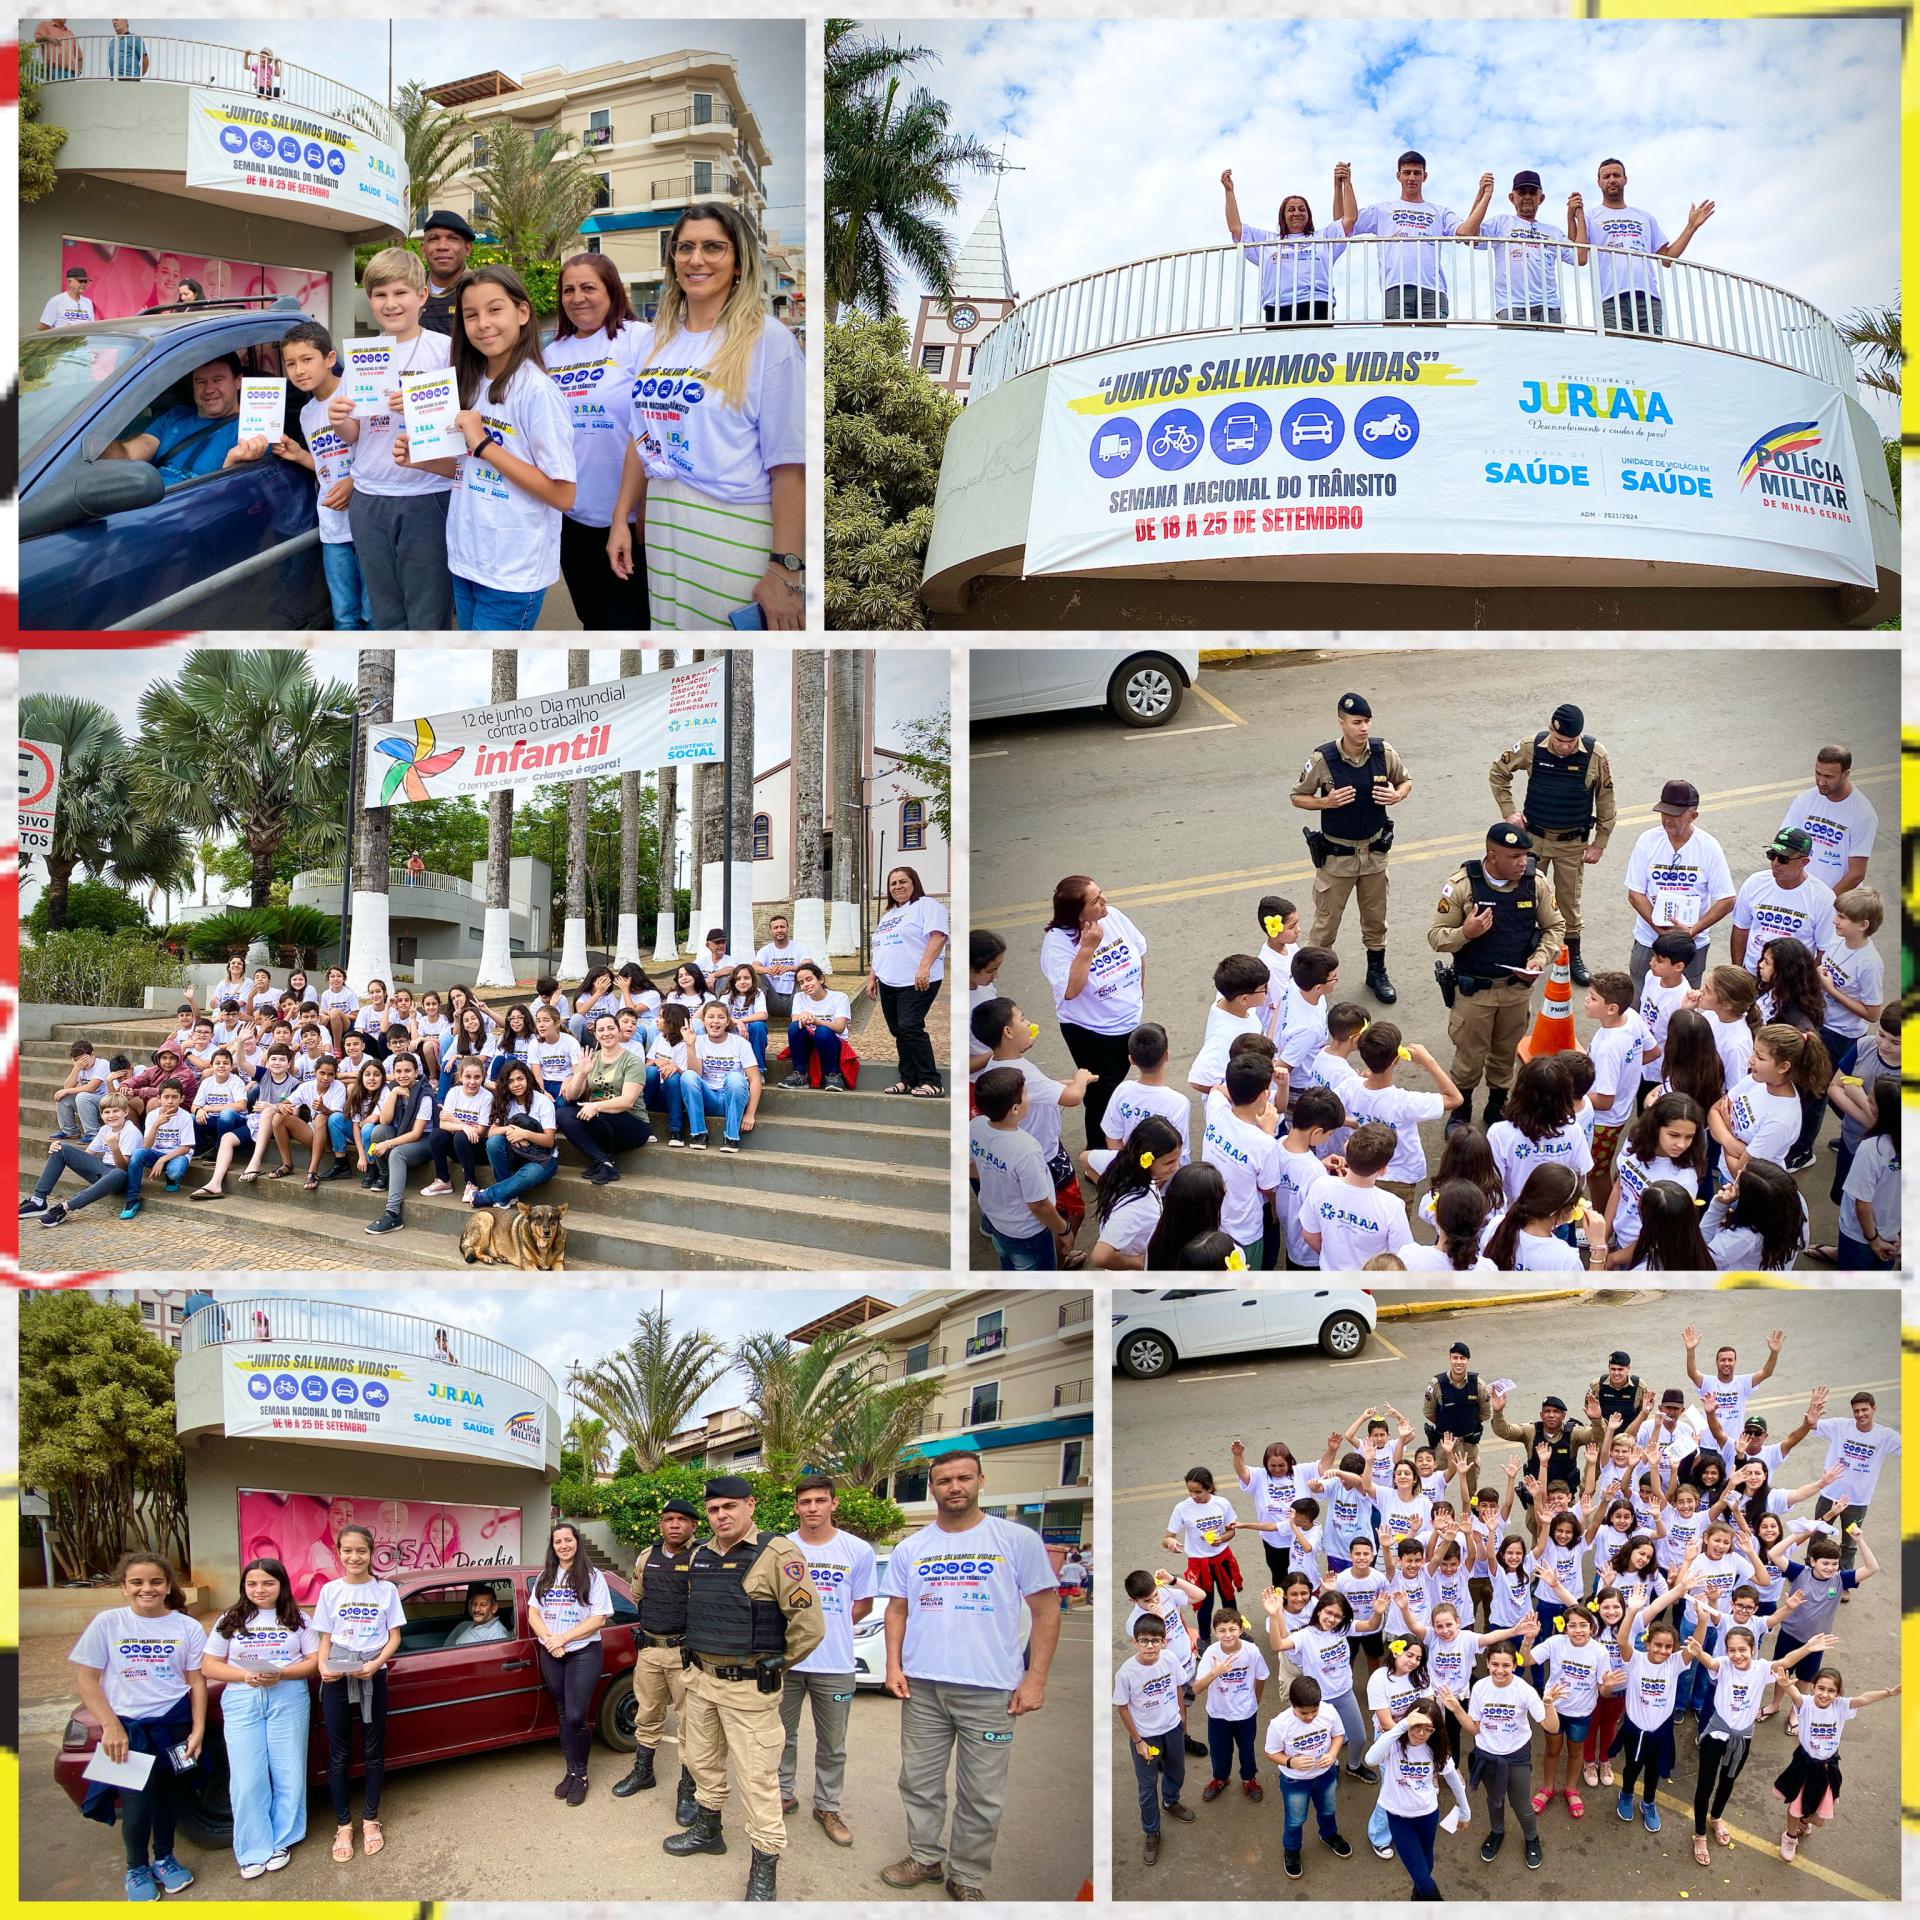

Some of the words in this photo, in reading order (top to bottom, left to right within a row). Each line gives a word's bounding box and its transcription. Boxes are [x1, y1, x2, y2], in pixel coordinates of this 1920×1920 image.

[271, 113, 323, 139] SALVAMOS
[233, 159, 266, 175] SEMANA
[267, 164, 301, 180] NACIONAL
[302, 170, 312, 182] DO
[246, 174, 257, 185] DE
[276, 178, 286, 191] 25
[288, 181, 296, 192] DE
[297, 183, 330, 199] SETEMBRO
[1196, 352, 1337, 392] SALVAMOS
[1561, 375, 1620, 384] PREFEITURA
[1518, 380, 1674, 425] JURUAIA
[1485, 457, 1590, 487] SAÚDE
[1621, 457, 1654, 467] UNIDADE
[1655, 460, 1665, 468] DE
[1699, 465, 1710, 473] EM
[1756, 446, 1845, 486] POLÍCIA
[1109, 484, 1178, 514] SEMANA
[1183, 477, 1271, 506] NACIONAL
[1276, 475, 1302, 499] DO
[1307, 467, 1397, 498] TRÂNSITO
[1621, 468, 1714, 499] SAÚDE
[1759, 472, 1849, 511] MILITAR
[1135, 517, 1156, 542] DE
[1161, 515, 1181, 540] 18
[1186, 513, 1198, 538] A
[1203, 511, 1228, 536] 25
[1233, 509, 1256, 534] DE
[1261, 505, 1363, 533] SETEMBRO
[1603, 512, 1638, 520] 2021/2024
[1763, 498, 1777, 508] DE
[1781, 501, 1816, 516] MINAS
[1819, 509, 1851, 524] GERAIS
[671, 675, 691, 684] FAÇA
[461, 713, 477, 728] 12
[478, 710, 494, 726] de
[494, 705, 533, 726] junho
[541, 698, 563, 715] Dia
[565, 684, 626, 711] mundial
[487, 722, 527, 740] contra
[529, 721, 539, 733] o
[540, 709, 599, 731] trabalho
[474, 724, 612, 777] infantil
[667, 747, 717, 760] SOCIAL
[458, 782, 466, 791] O
[466, 777, 498, 791] tempo
[499, 777, 512, 787] de
[514, 775, 528, 785] ser
[532, 769, 573, 782] Criança
[575, 765, 583, 774] é
[583, 757, 621, 776] agora!
[20, 832, 49, 847] TOS
[293, 1354, 354, 1373] SALVAMOS
[260, 1405, 290, 1416] SEMANA
[292, 1406, 329, 1418] NACIONAL
[331, 1408, 342, 1419] DO
[344, 1407, 381, 1422] TRÂNSITO
[272, 1418, 282, 1429] DE
[301, 1419, 312, 1430] 25
[314, 1420, 324, 1430] DE
[326, 1421, 368, 1433] SETEMBRO
[413, 1411, 452, 1427] SAÚDE
[510, 1419, 541, 1436] POLÍCIA
[510, 1428, 541, 1445] MILITAR
[371, 1539, 441, 1572] OSA
